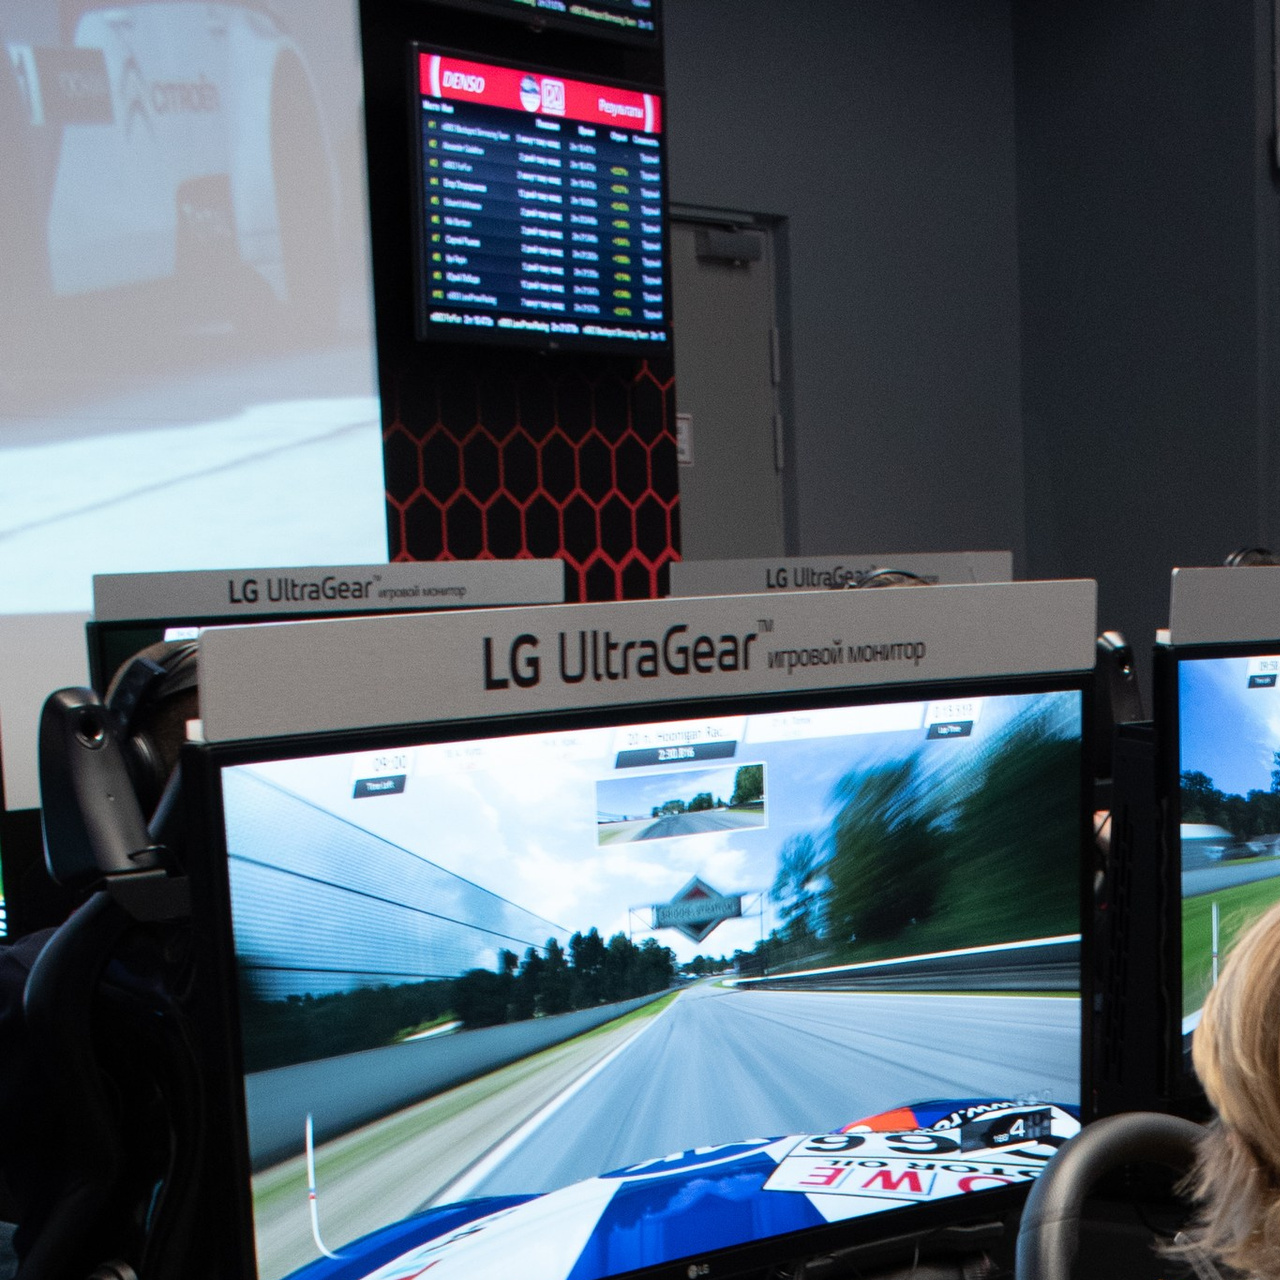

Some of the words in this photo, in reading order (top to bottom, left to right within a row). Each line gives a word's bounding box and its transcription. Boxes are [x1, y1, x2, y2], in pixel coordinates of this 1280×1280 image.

[442, 70, 486, 94] DENSO
[228, 578, 259, 604] LG
[766, 567, 788, 589] LG
[483, 633, 541, 691] LG
[767, 640, 844, 676] игровой
[847, 639, 927, 668] монитор
